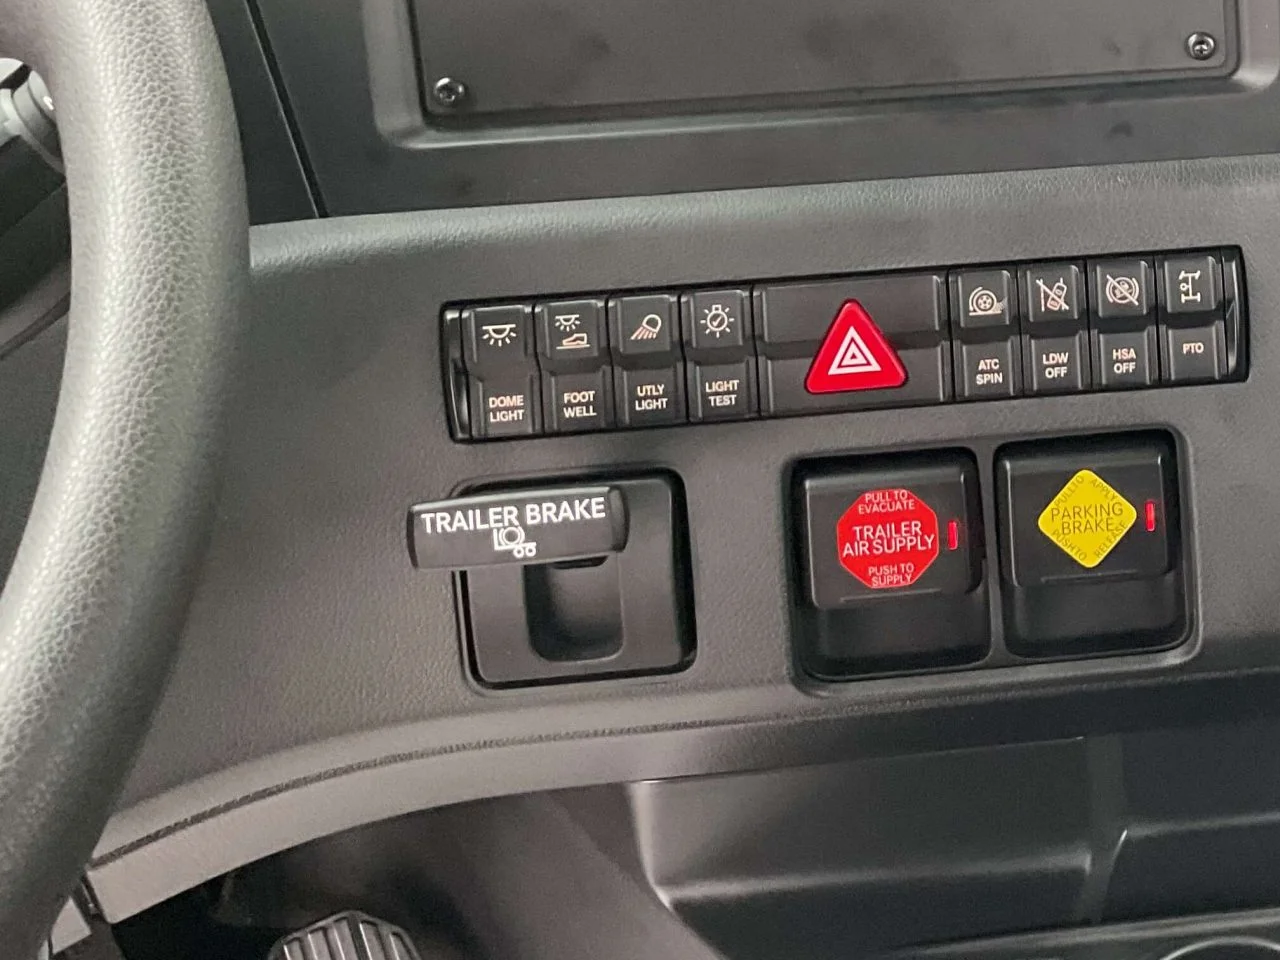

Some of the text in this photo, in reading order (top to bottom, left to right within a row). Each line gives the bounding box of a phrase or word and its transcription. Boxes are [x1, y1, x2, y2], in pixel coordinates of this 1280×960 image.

[1112, 348, 1137, 361] HSA
[1182, 341, 1205, 355] PTO
[978, 358, 1000, 371] ATC
[1042, 351, 1069, 365] LDW
[1045, 365, 1069, 379] OFF
[1113, 361, 1137, 374] OFF
[705, 378, 740, 393] LIGHT
[975, 371, 1004, 386] SPIN
[563, 390, 596, 404] FOOT
[636, 383, 665, 397] UTLY
[488, 394, 525, 409] DOME
[635, 396, 668, 411] LIGHT
[708, 393, 738, 407] TEST
[489, 408, 524, 423] LIGHT
[563, 403, 597, 419] WELL
[865, 489, 908, 503] PULL TO
[858, 499, 915, 515] EVACUATE
[1050, 501, 1124, 523] PARKING
[420, 496, 606, 535] TRAILER BRAKE
[852, 520, 922, 541] TRAILER
[1061, 516, 1114, 536] BRAKE
[842, 533, 935, 558] AIR SUPPLY
[868, 562, 914, 576] PUSH TO
[870, 573, 912, 587] SUPPLY
